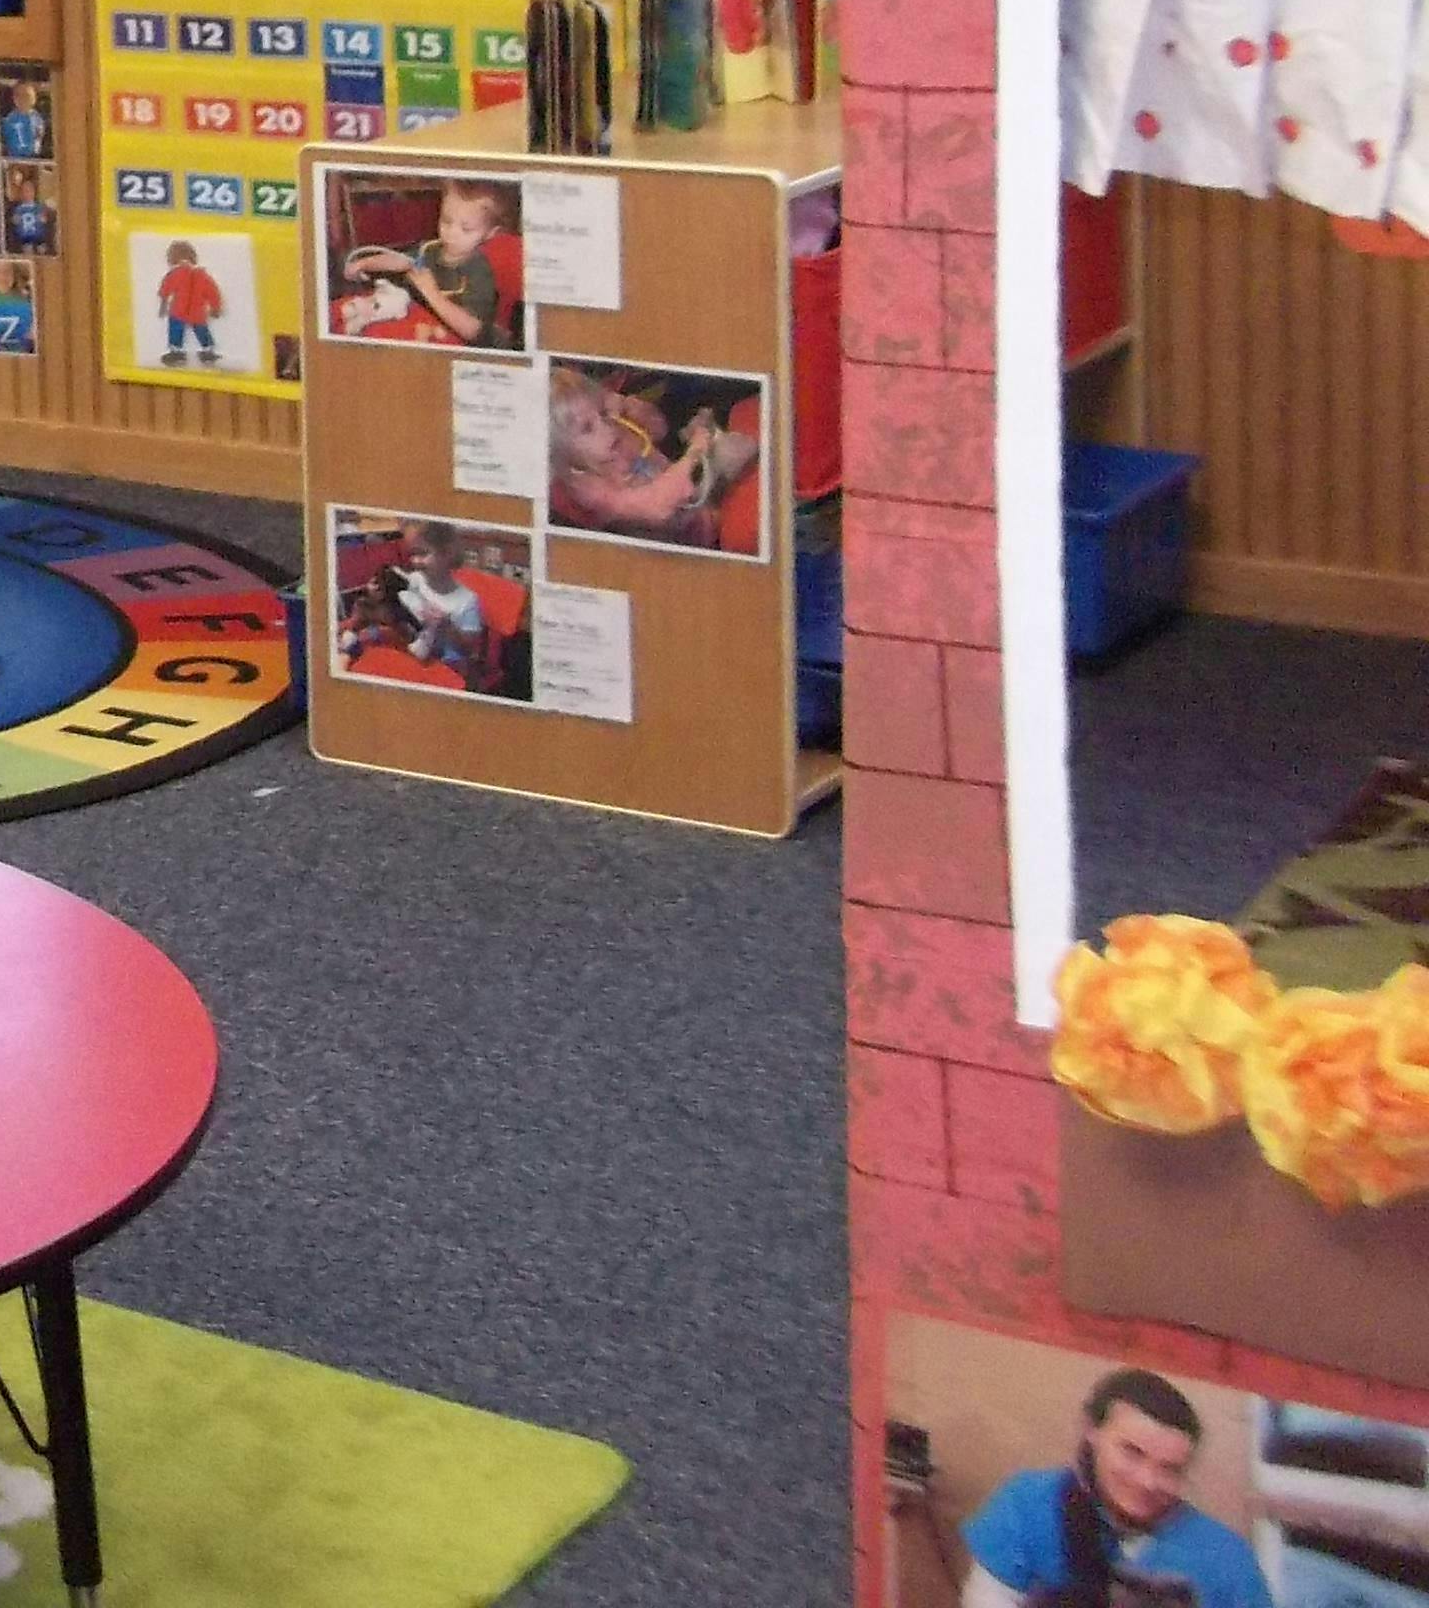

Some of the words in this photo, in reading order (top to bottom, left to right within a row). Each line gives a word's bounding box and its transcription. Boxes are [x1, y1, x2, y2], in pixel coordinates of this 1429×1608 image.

[126, 18, 155, 44] 11
[185, 21, 224, 48] 12
[258, 24, 297, 52] 13
[327, 28, 371, 57] 14
[404, 31, 443, 59] 15
[485, 35, 527, 63] 16
[120, 97, 154, 123] 18
[193, 103, 231, 129] 19
[256, 106, 302, 134] 20
[334, 111, 373, 140] 21
[121, 176, 167, 202] 25
[191, 180, 238, 207] 26
[256, 183, 298, 211] 27
[8, 519, 103, 549] D
[113, 561, 221, 591] E
[163, 610, 268, 638] F
[154, 655, 261, 690] G
[59, 706, 197, 747] H
